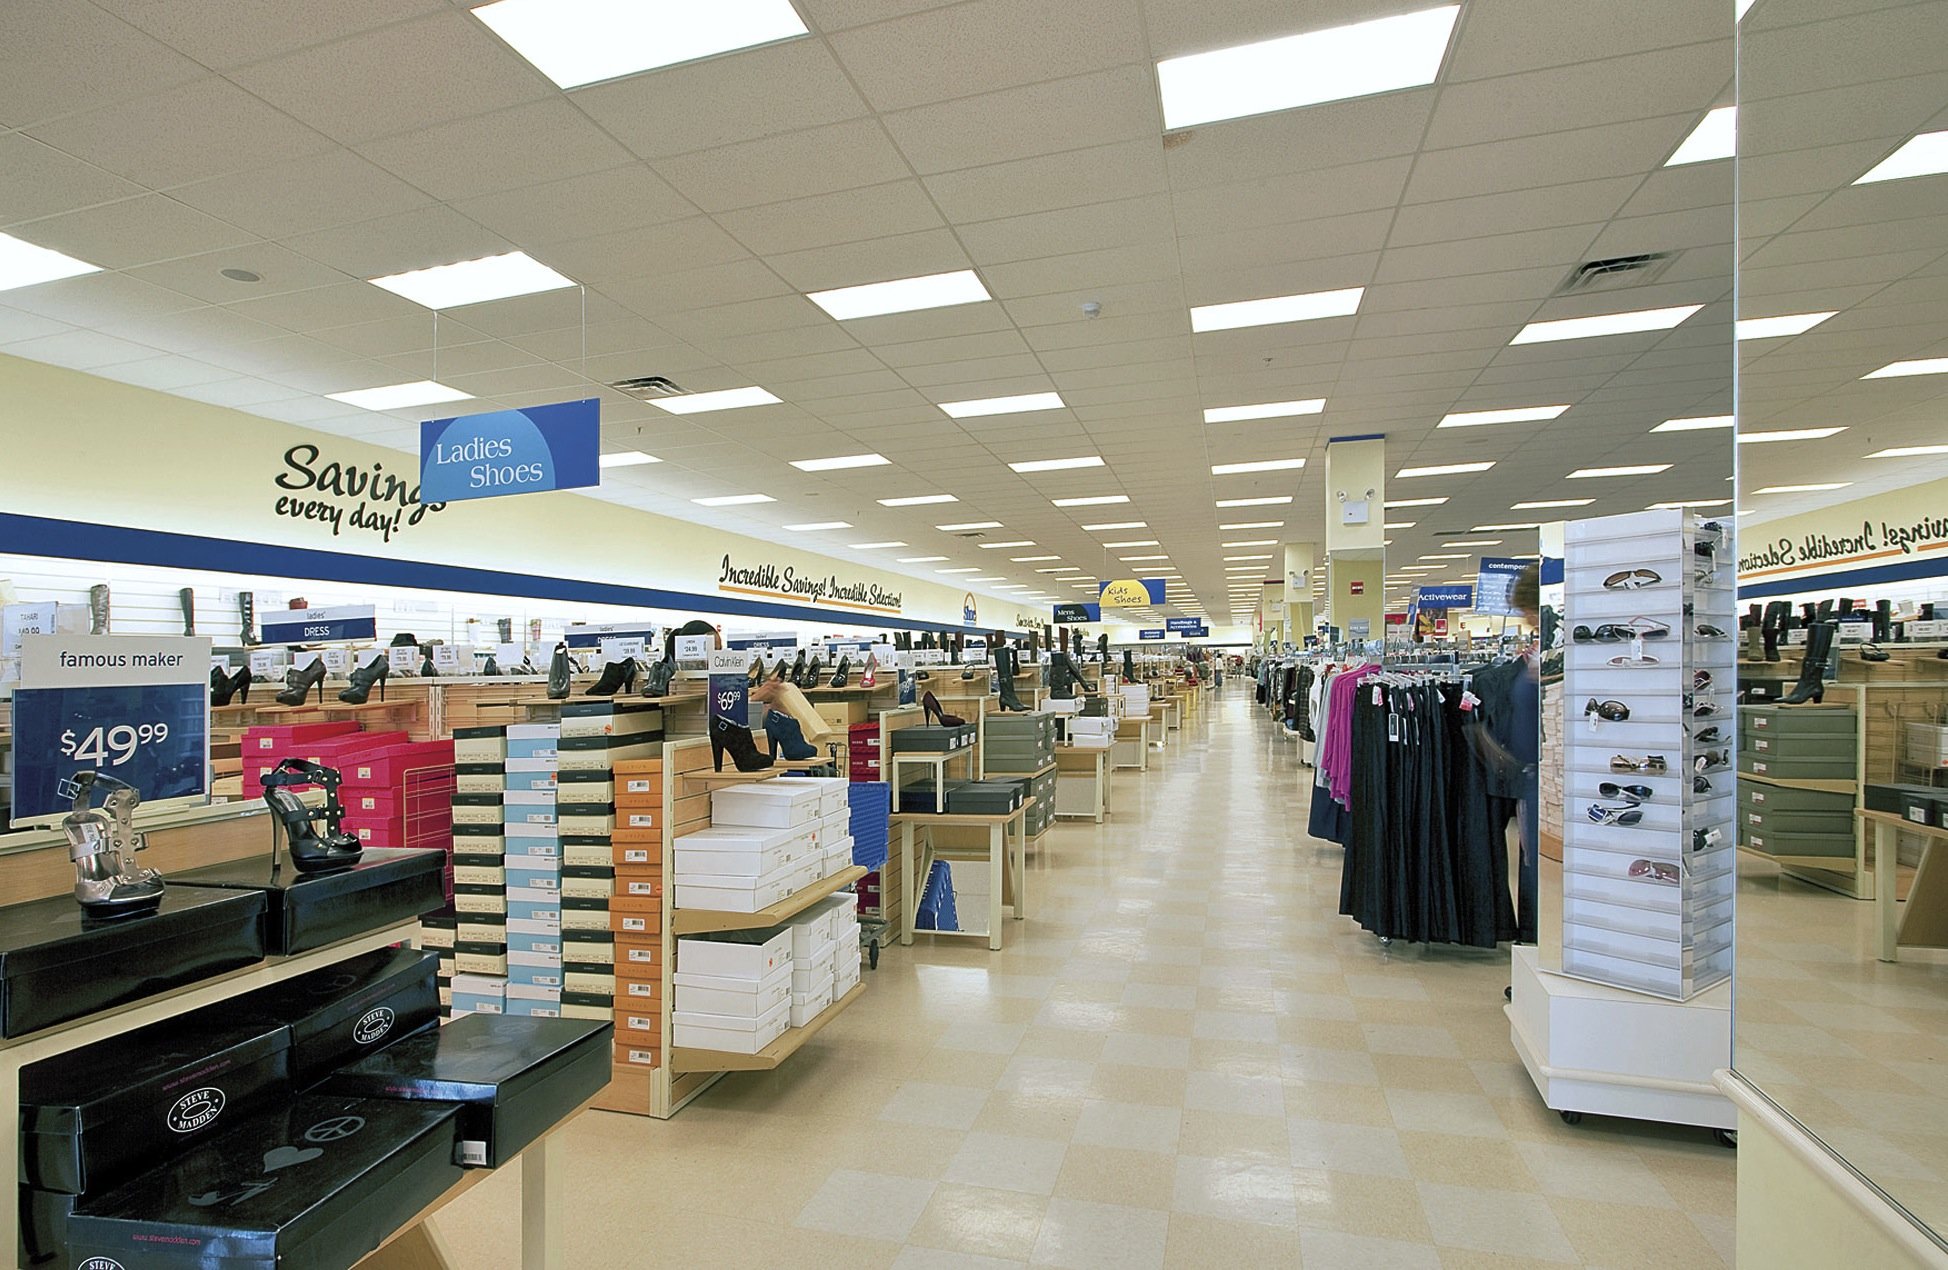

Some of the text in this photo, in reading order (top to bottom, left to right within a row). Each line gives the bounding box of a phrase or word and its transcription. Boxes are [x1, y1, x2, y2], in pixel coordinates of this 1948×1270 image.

[436, 437, 512, 465] Ladies
[470, 462, 543, 488] Shoes
[275, 496, 402, 543] every day!
[719, 553, 779, 589] Incredible
[781, 566, 827, 603] Savings!
[828, 575, 868, 603] Incredible
[1107, 586, 1128, 595] Kids
[1114, 595, 1142, 604] Shoes
[1419, 593, 1467, 601] Activewear
[304, 626, 330, 637] DRESS
[59, 651, 183, 667] famous maker
[714, 656, 732, 667] Calvin
[362, 1009, 385, 1026] STEVE
[361, 1022, 389, 1042] MADDEN
[179, 1090, 210, 1110] STEVE
[177, 1105, 218, 1130] MADDEN
